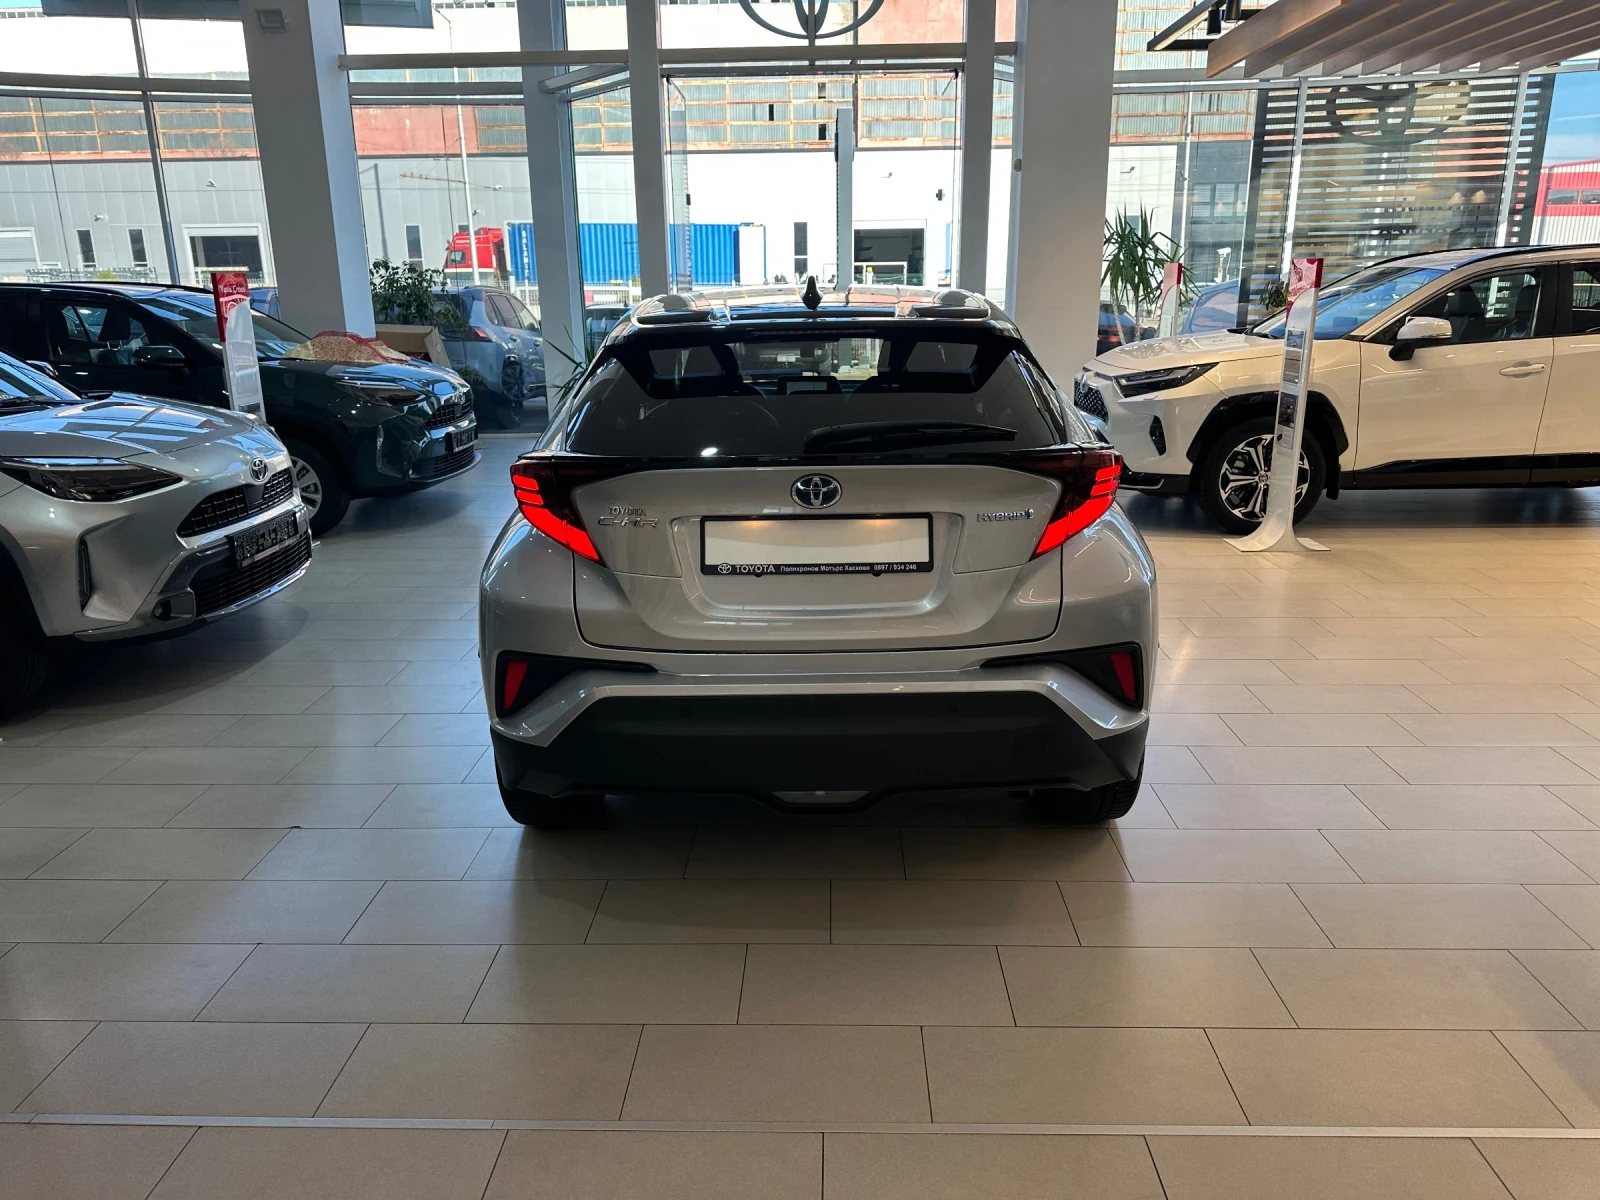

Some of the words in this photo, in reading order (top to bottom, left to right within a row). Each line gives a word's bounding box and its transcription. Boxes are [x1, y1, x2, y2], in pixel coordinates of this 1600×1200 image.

[232, 284, 246, 292] Cross
[608, 506, 647, 516] TOYOTA
[976, 510, 1025, 522] HYBRID
[735, 564, 776, 573] TOYOTA
[780, 565, 819, 573] Полихронов
